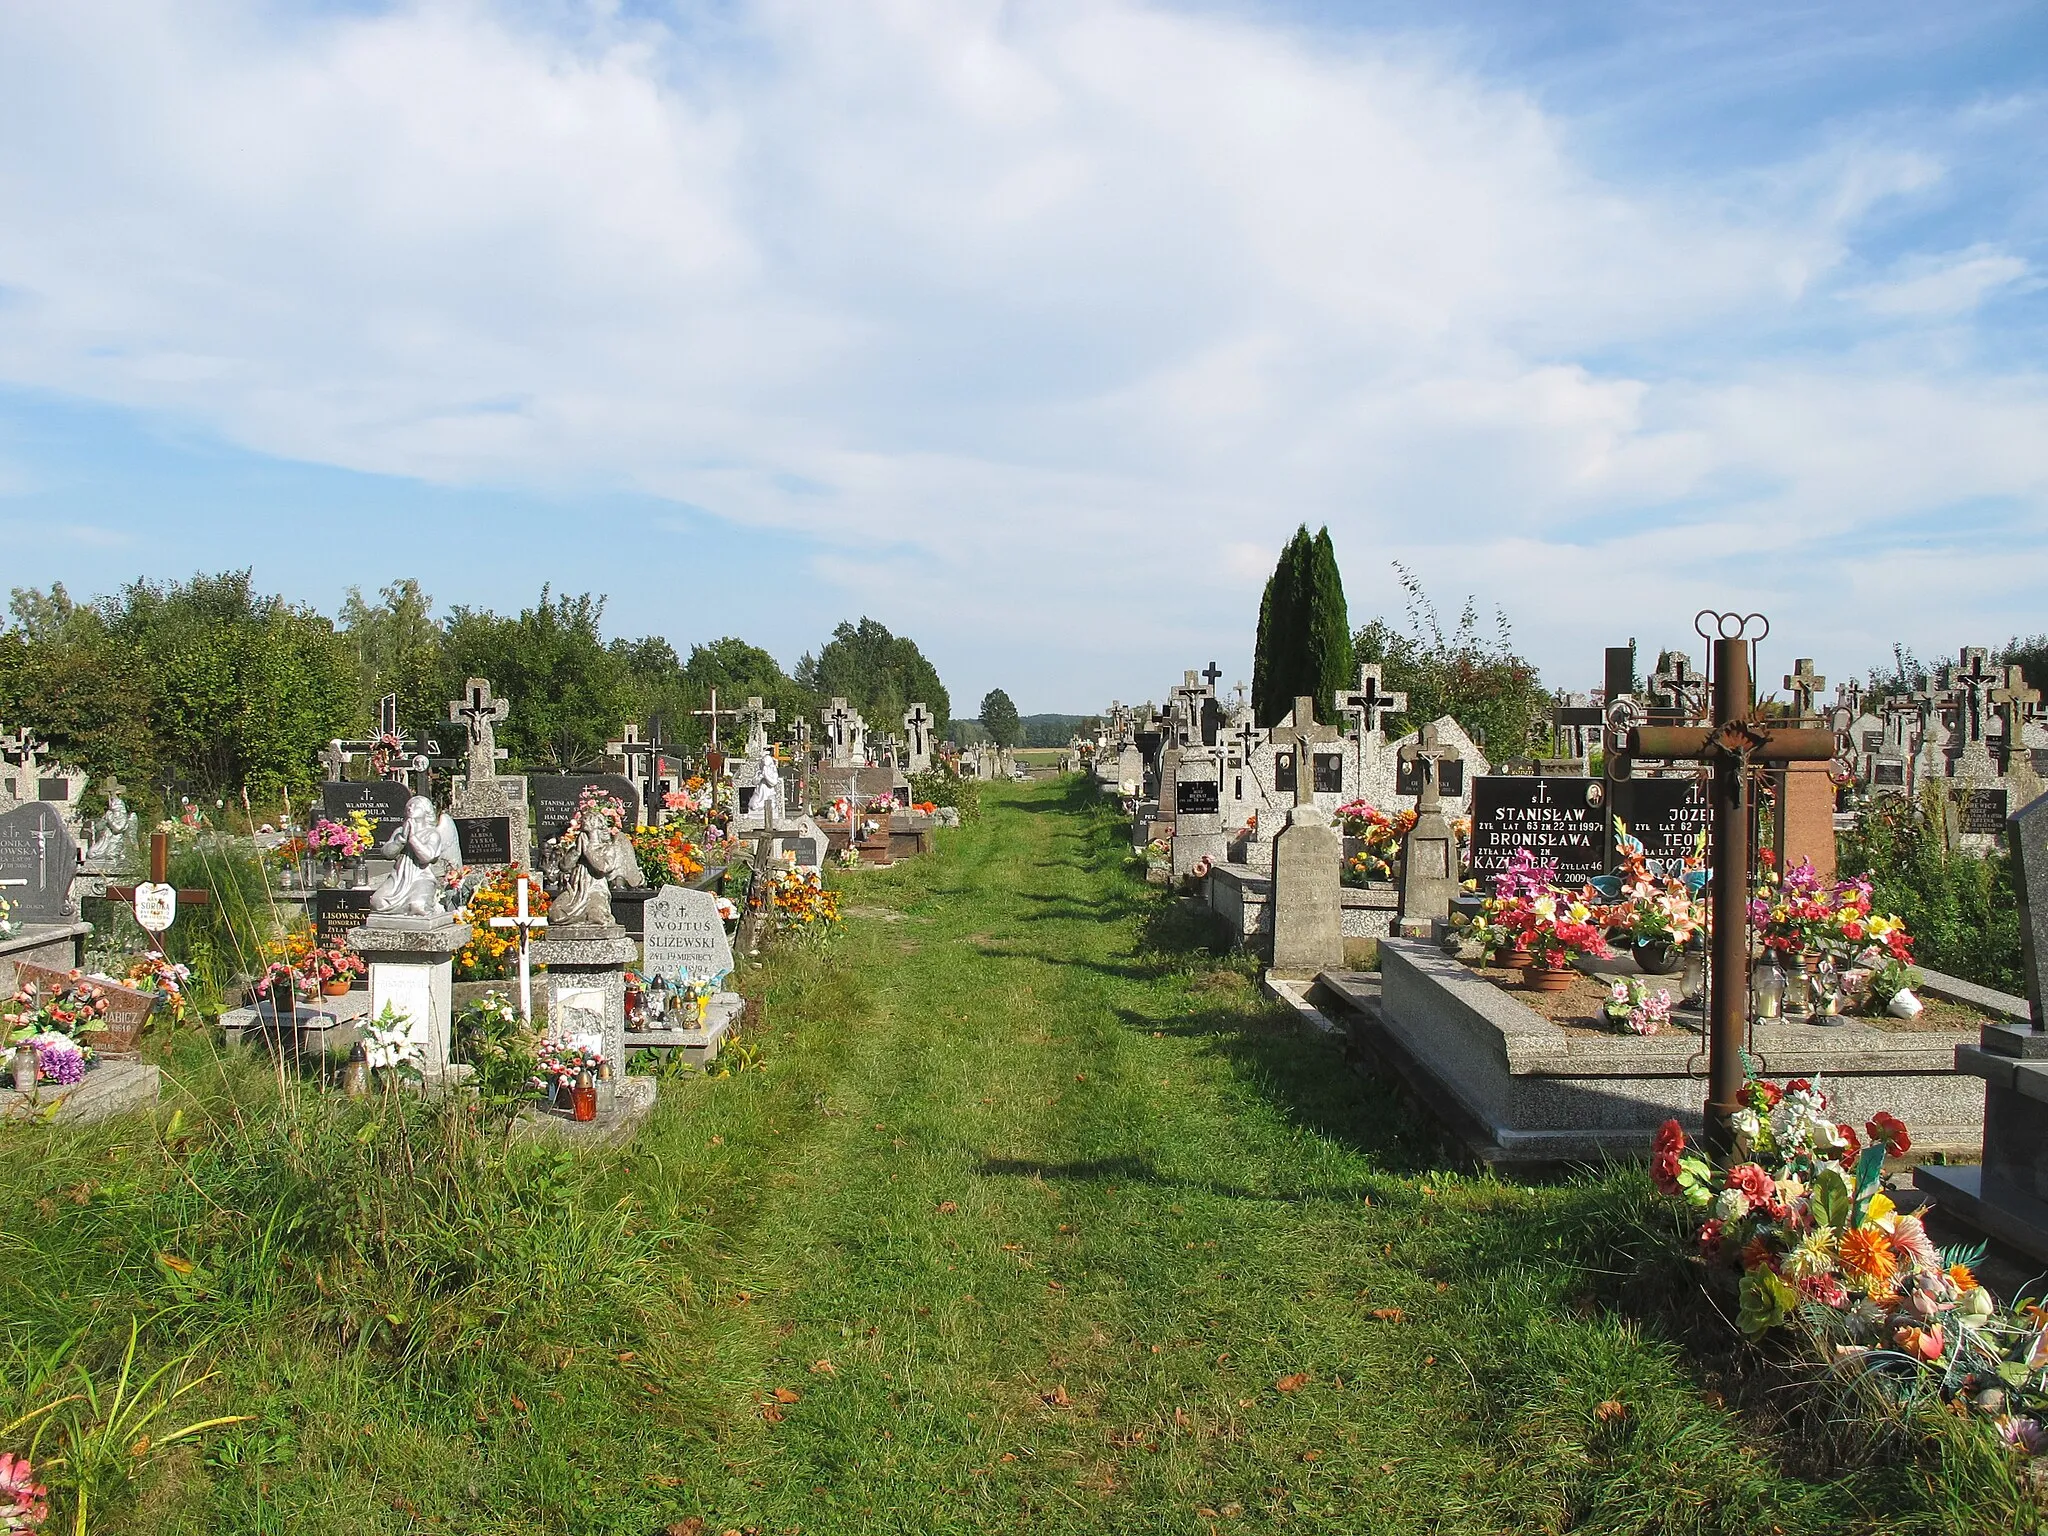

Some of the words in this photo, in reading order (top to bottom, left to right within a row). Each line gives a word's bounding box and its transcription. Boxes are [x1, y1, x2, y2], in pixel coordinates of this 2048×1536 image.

[1495, 806, 1586, 821] STANISŁAW
[1502, 822, 1520, 831] LAT
[1526, 821, 1538, 831] 63
[1553, 821, 1565, 831] 22
[1680, 821, 1692, 831] 62
[1490, 832, 1591, 847] BRONISŁAWA
[1590, 860, 1603, 871] 46
[322, 911, 367, 920] LISOWSKA
[654, 920, 711, 932] WOJTUŚ
[649, 934, 715, 949] ŚLIŻEWSKI
